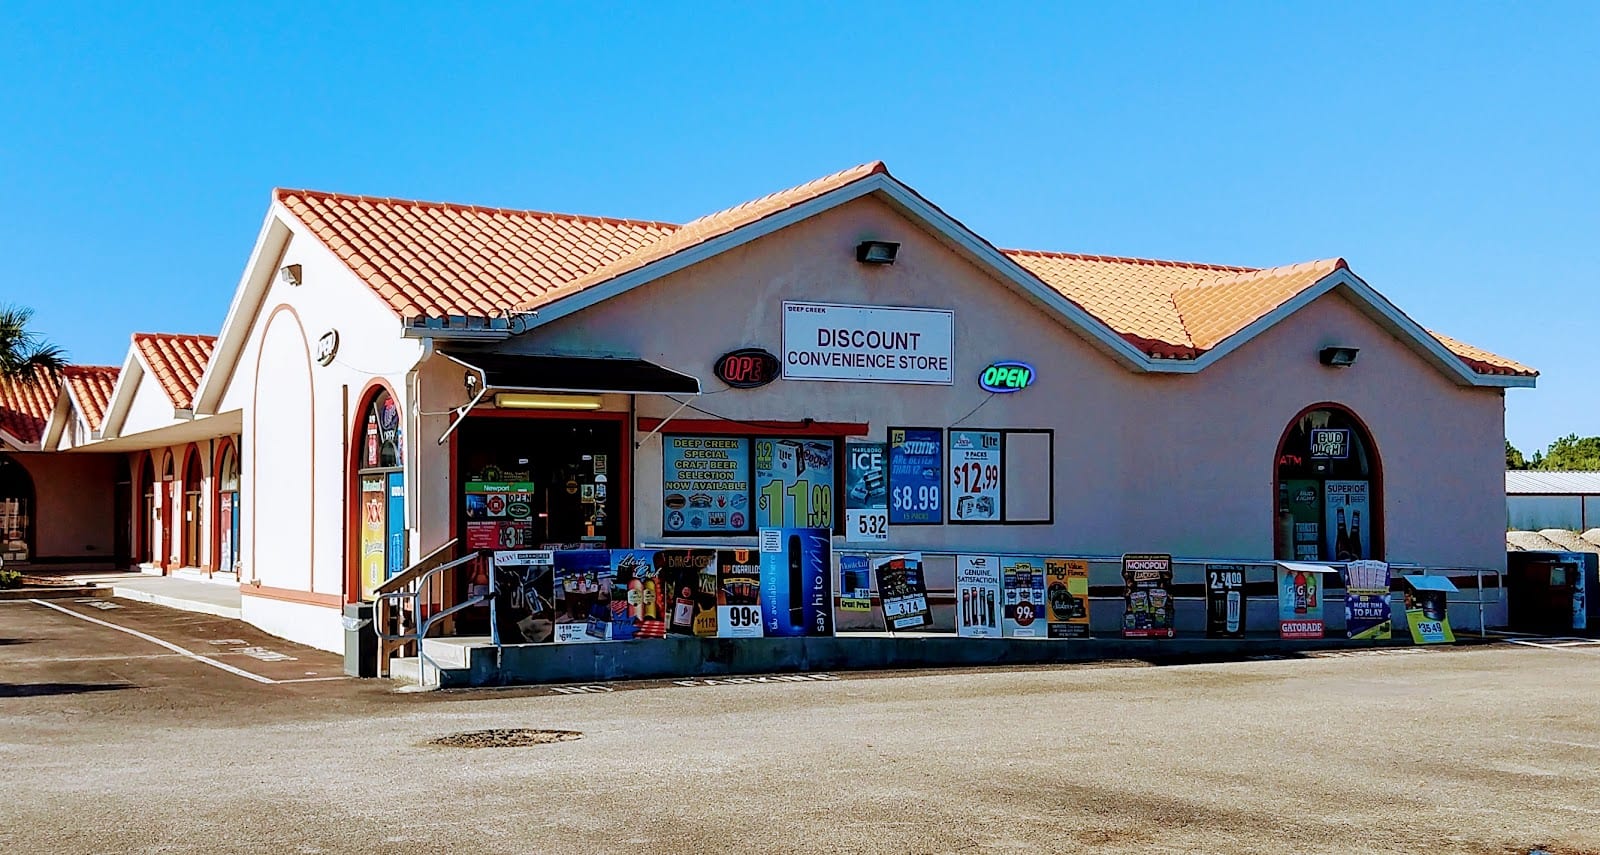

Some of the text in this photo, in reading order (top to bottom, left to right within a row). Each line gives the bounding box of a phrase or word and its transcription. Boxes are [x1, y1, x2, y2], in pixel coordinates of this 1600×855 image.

[818, 328, 920, 351] DISCOUNT
[788, 351, 948, 371] CONVENIENCE STORE
[984, 367, 1029, 388] OPEN
[674, 439, 738, 448] DEEP CREEK
[894, 433, 903, 444] 15
[982, 435, 998, 448] Lite
[1318, 432, 1344, 444] BUD
[684, 450, 728, 459] SPECIAL
[756, 442, 773, 458] 12
[779, 450, 792, 460] Lite
[675, 461, 737, 469] CRAFT BEER
[852, 453, 882, 470] ICE
[1280, 455, 1302, 464] ATM
[678, 471, 734, 480] SELECTION
[954, 462, 998, 493] $12.99
[665, 482, 747, 491] NOW AVAILABLE
[509, 494, 532, 502] OPEN
[893, 486, 939, 511] $8.99
[620, 553, 646, 567] Liberty
[1127, 562, 1167, 570] MONOPOLY
[635, 566, 662, 579] Creek
[732, 565, 760, 574] CIGARILLOS
[814, 575, 823, 591] to
[812, 594, 823, 606] hi
[730, 607, 759, 627] 99¢
[1017, 606, 1034, 619] 99¢
[816, 610, 827, 632] say
[1282, 623, 1322, 632] GATORADE
